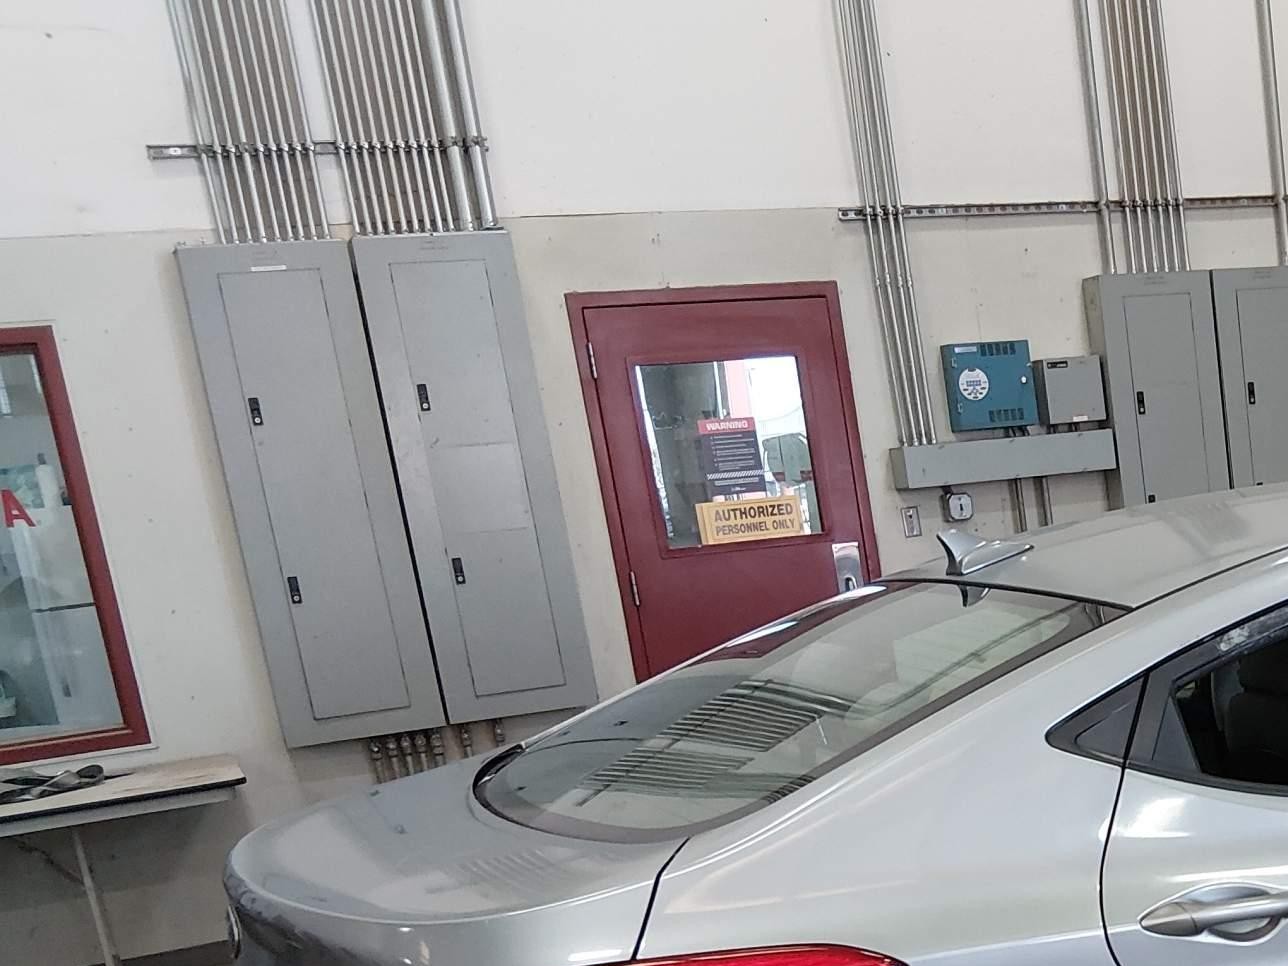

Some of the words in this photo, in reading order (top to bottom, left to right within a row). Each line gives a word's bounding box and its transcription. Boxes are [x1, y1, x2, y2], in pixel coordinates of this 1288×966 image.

[706, 420, 749, 431] WARNING
[714, 503, 794, 522] AUTHORIZED
[715, 521, 769, 537] PERSONNEL
[771, 518, 796, 531] ONLY
